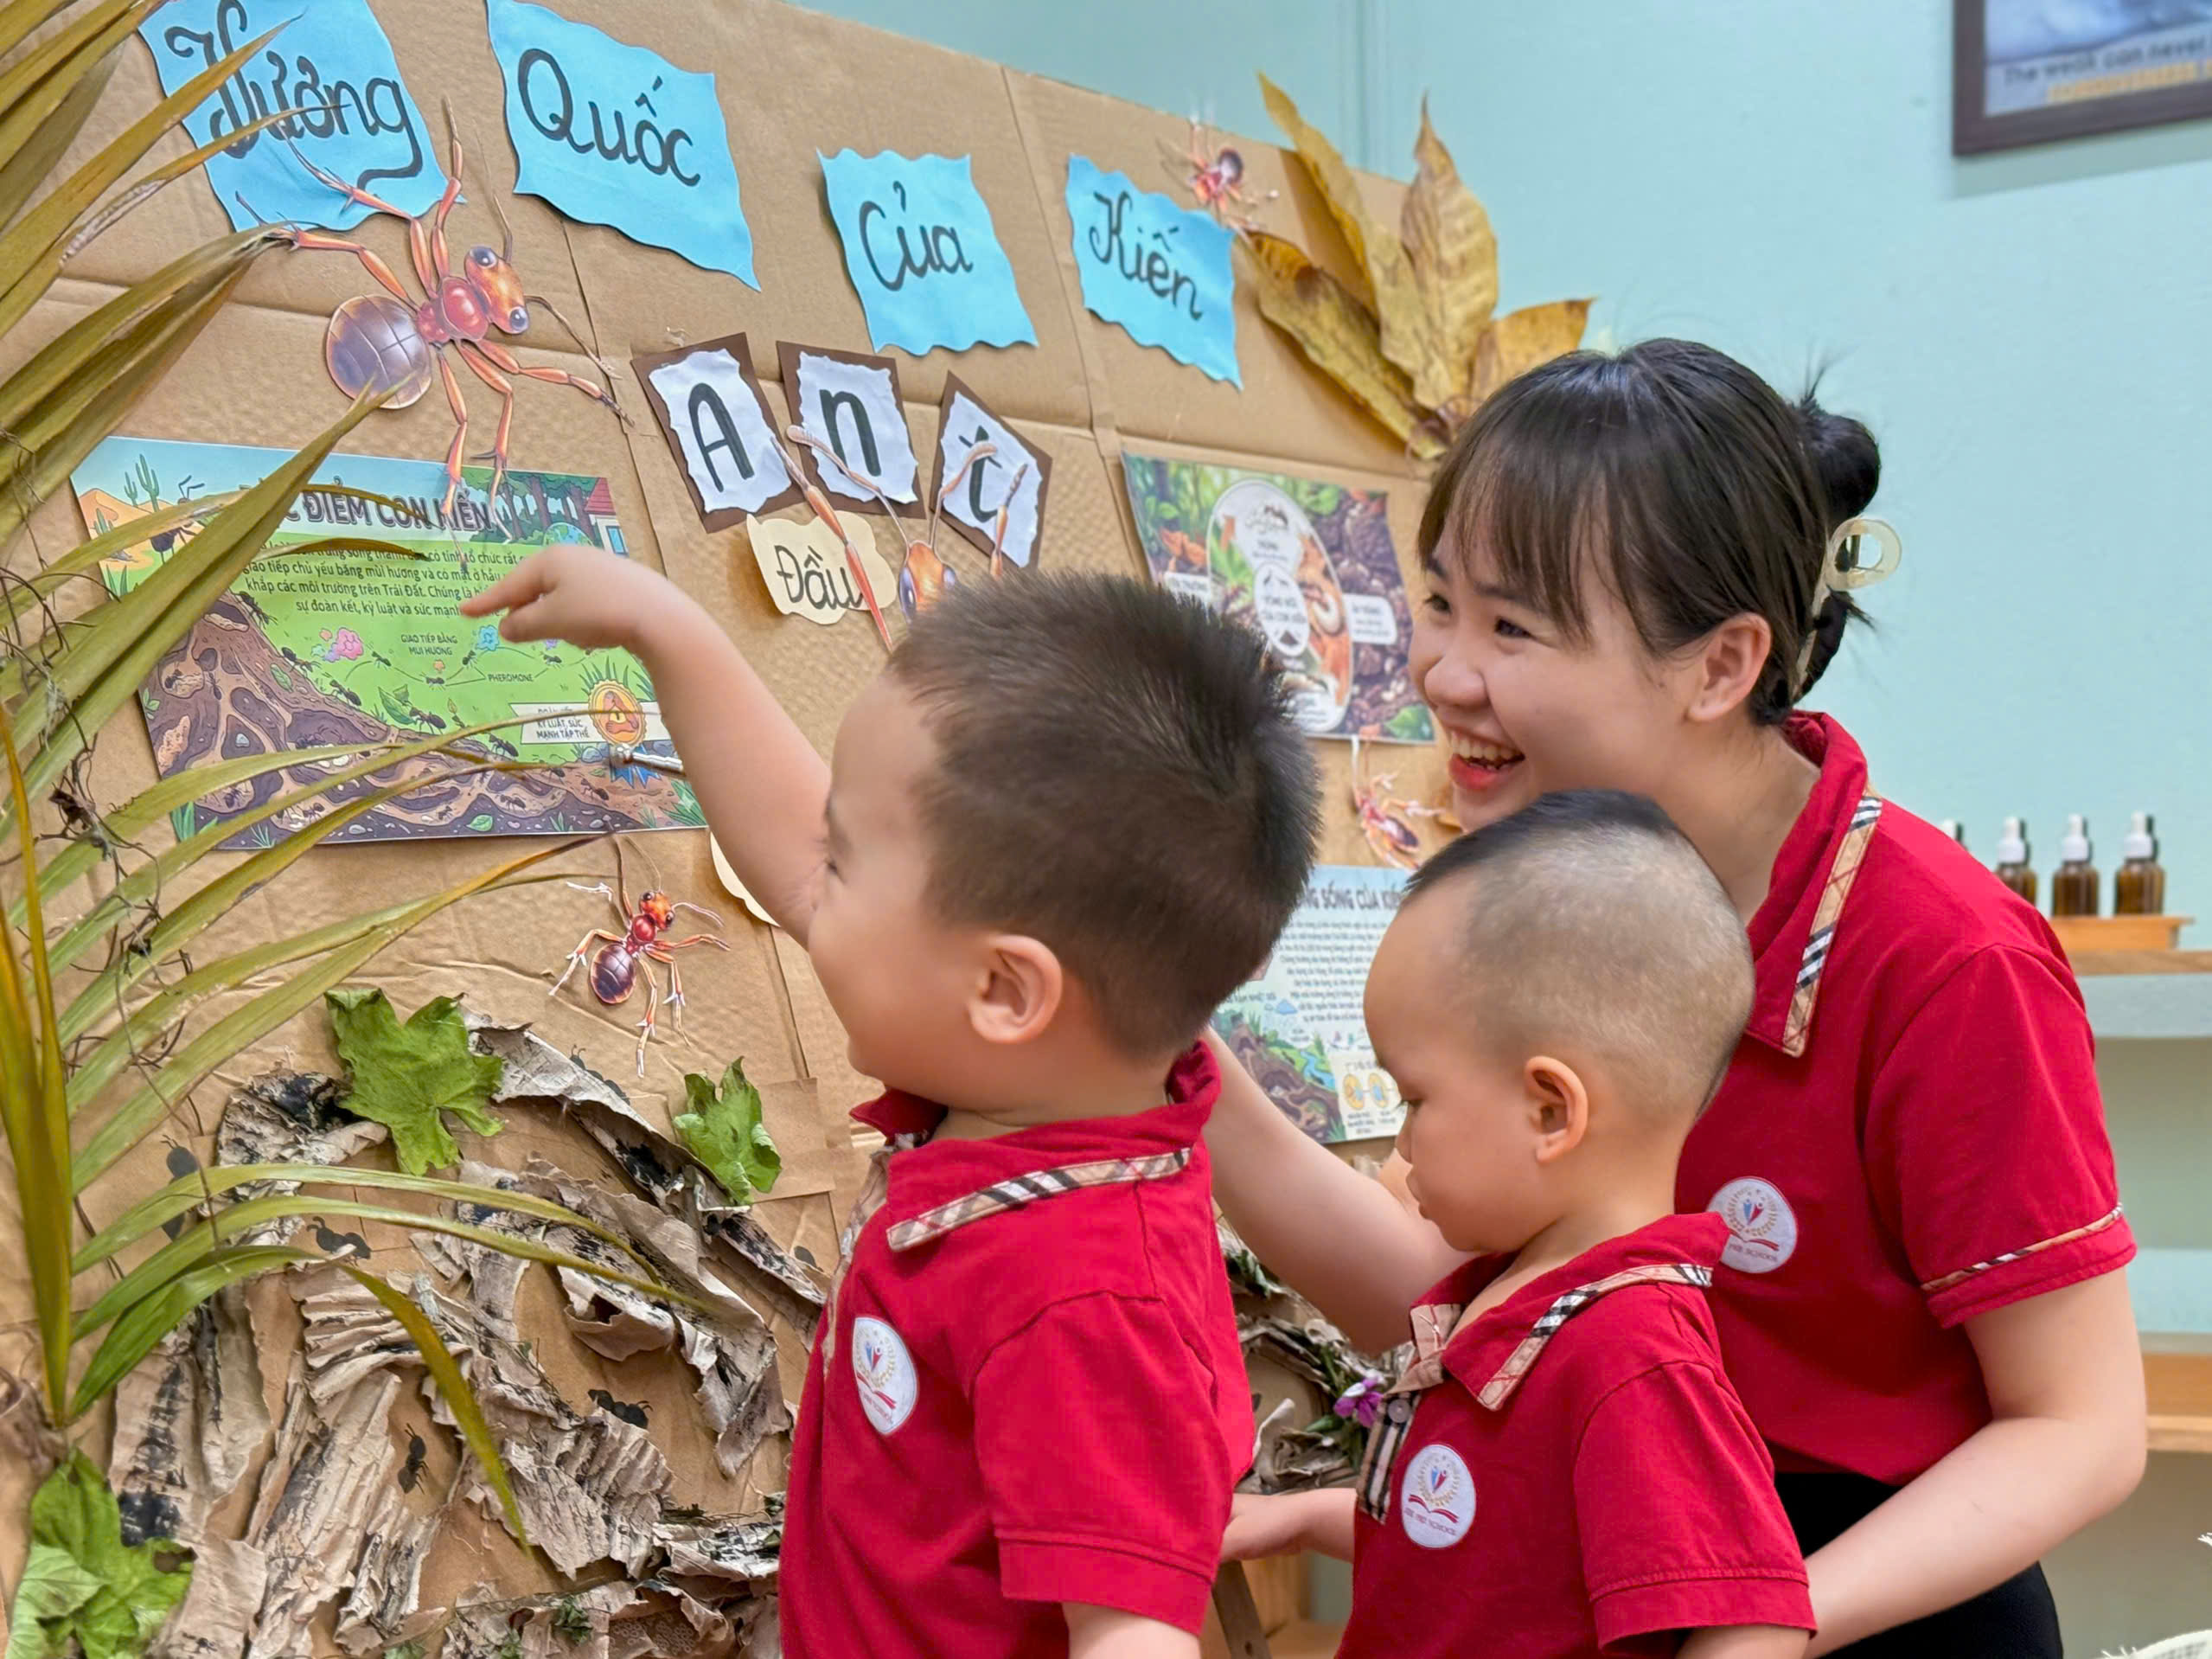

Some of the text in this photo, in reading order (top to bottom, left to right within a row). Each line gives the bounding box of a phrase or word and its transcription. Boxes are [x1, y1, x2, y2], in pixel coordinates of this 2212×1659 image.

[164, 0, 1203, 321] Vương Quốc Của Kiến
[267, 558, 290, 576] tiếp
[774, 545, 865, 610] Đầu
[277, 579, 297, 592] các
[298, 580, 320, 593] môi
[359, 582, 381, 596] trên
[381, 583, 403, 597] Trái
[427, 585, 462, 601] Chúng
[310, 599, 339, 612] đoàn
[400, 634, 419, 644] GIAO
[488, 673, 534, 682] PHEROMONE
